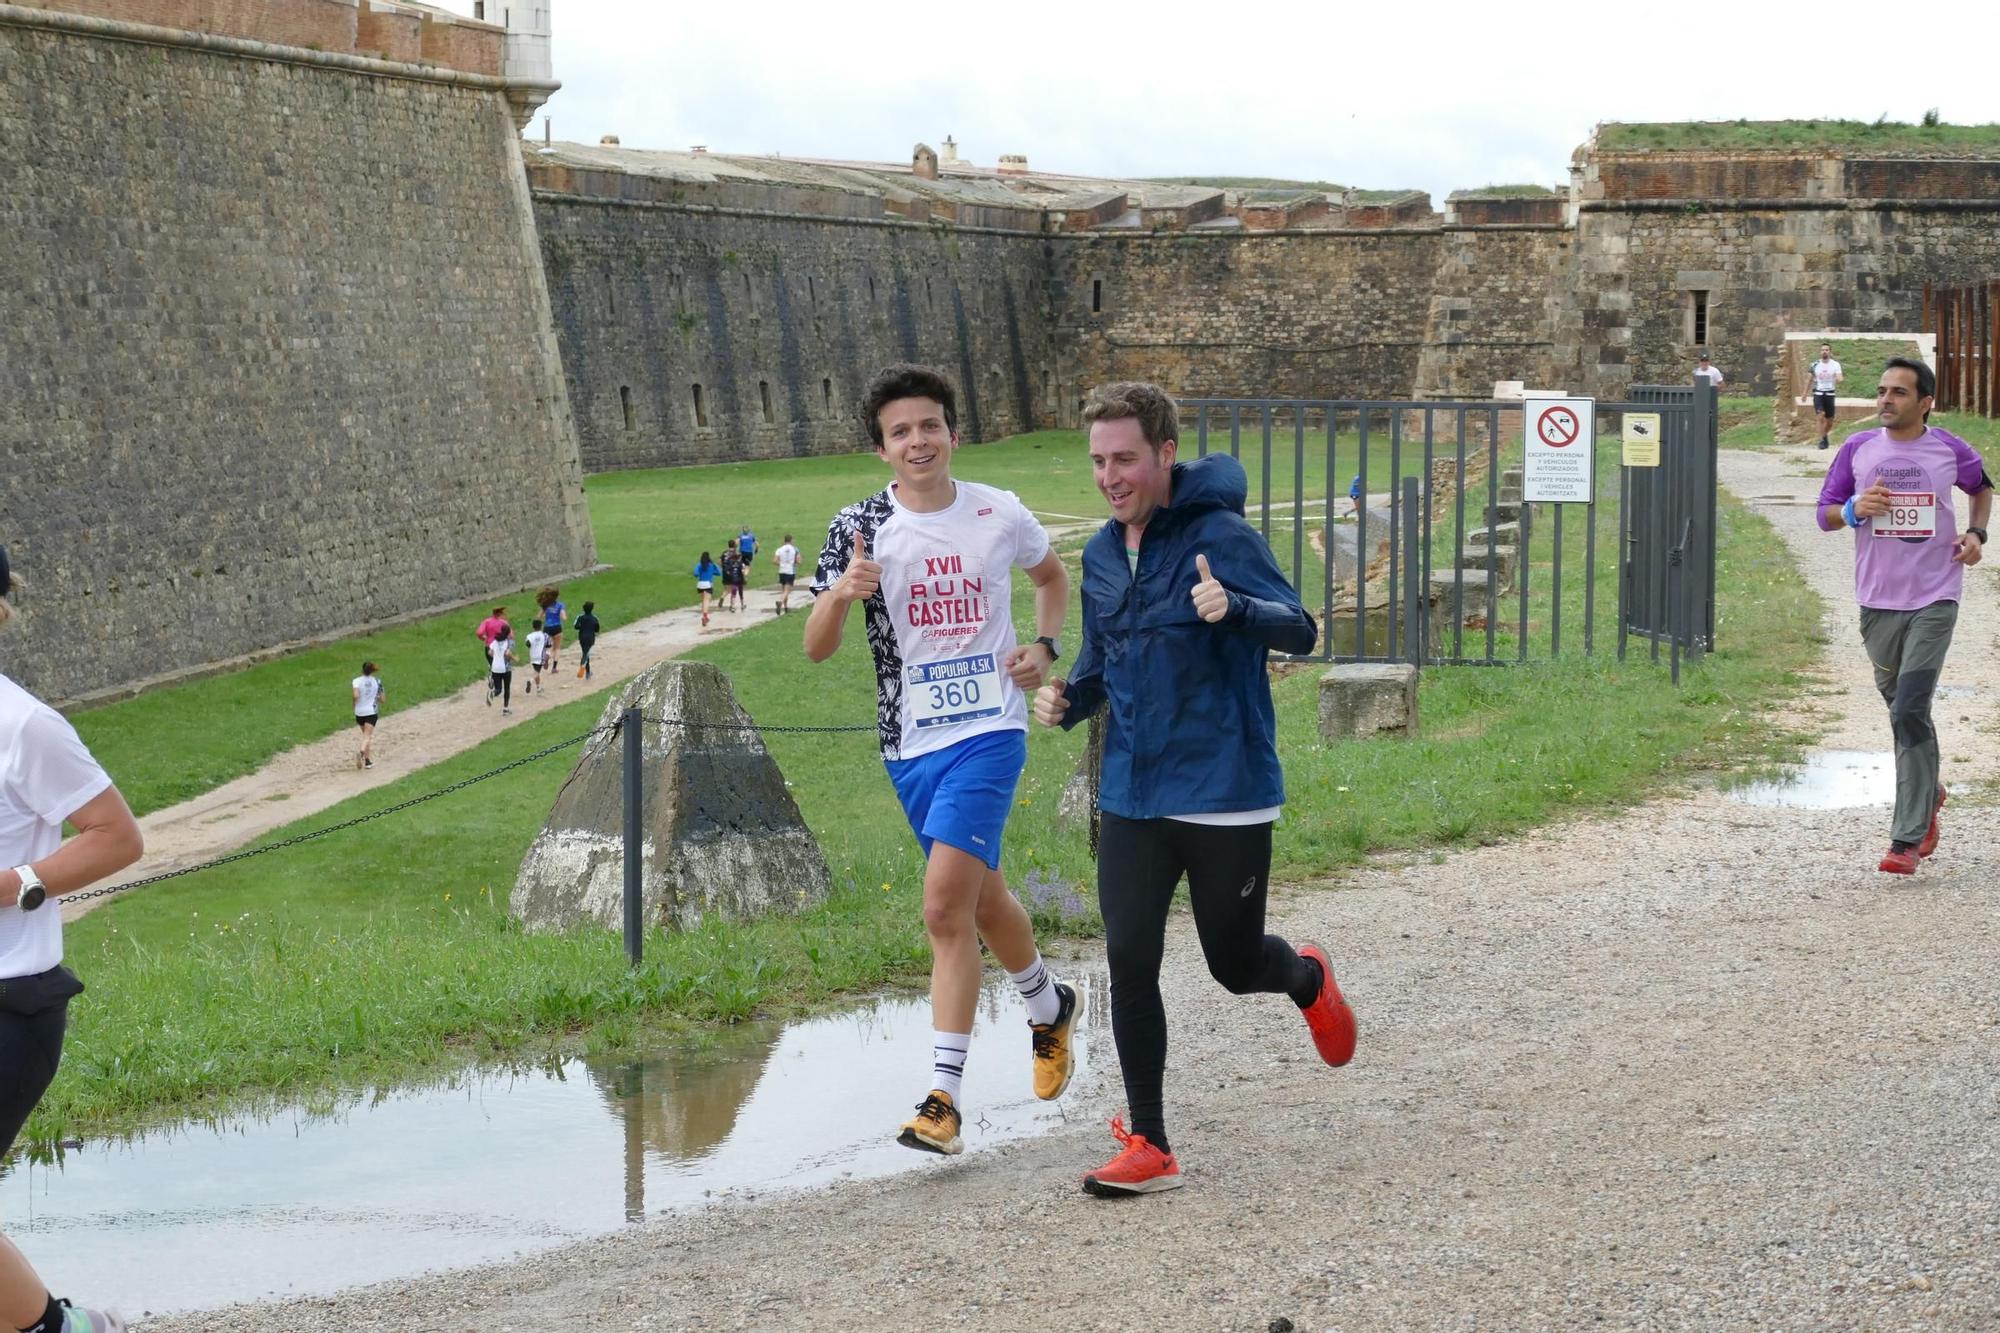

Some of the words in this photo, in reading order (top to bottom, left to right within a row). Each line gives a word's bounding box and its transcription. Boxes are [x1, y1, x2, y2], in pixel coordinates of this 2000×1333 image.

[1875, 467, 1920, 480] Matagalls
[1882, 480, 1920, 490] ontserrat
[1890, 509, 1918, 525] 199
[924, 555, 963, 577] XVII
[910, 577, 982, 599] RUN
[908, 597, 984, 628] CASTELL
[929, 662, 970, 680] POPULAR
[971, 658, 991, 673] 4.5K
[929, 679, 980, 710] 360
